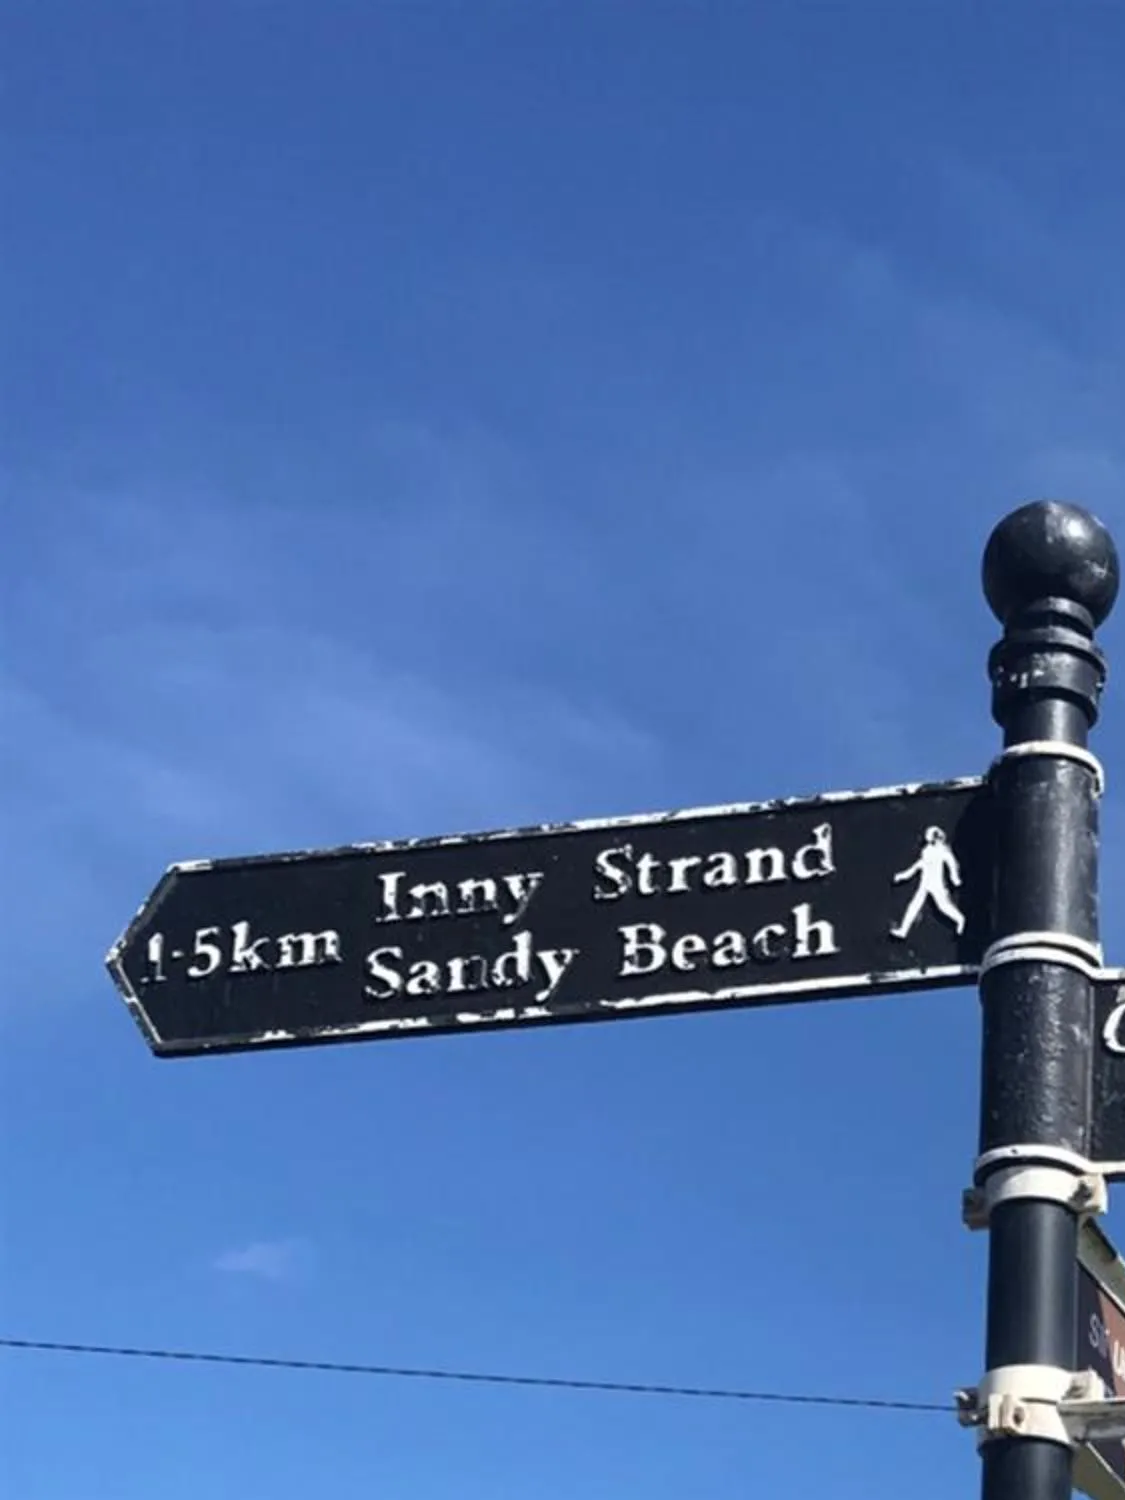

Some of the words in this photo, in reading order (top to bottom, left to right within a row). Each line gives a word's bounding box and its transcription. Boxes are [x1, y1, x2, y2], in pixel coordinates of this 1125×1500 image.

[377, 870, 544, 925] Inny
[594, 823, 835, 899] Strand
[365, 930, 579, 1002] Sandy
[618, 902, 838, 976] Beach
